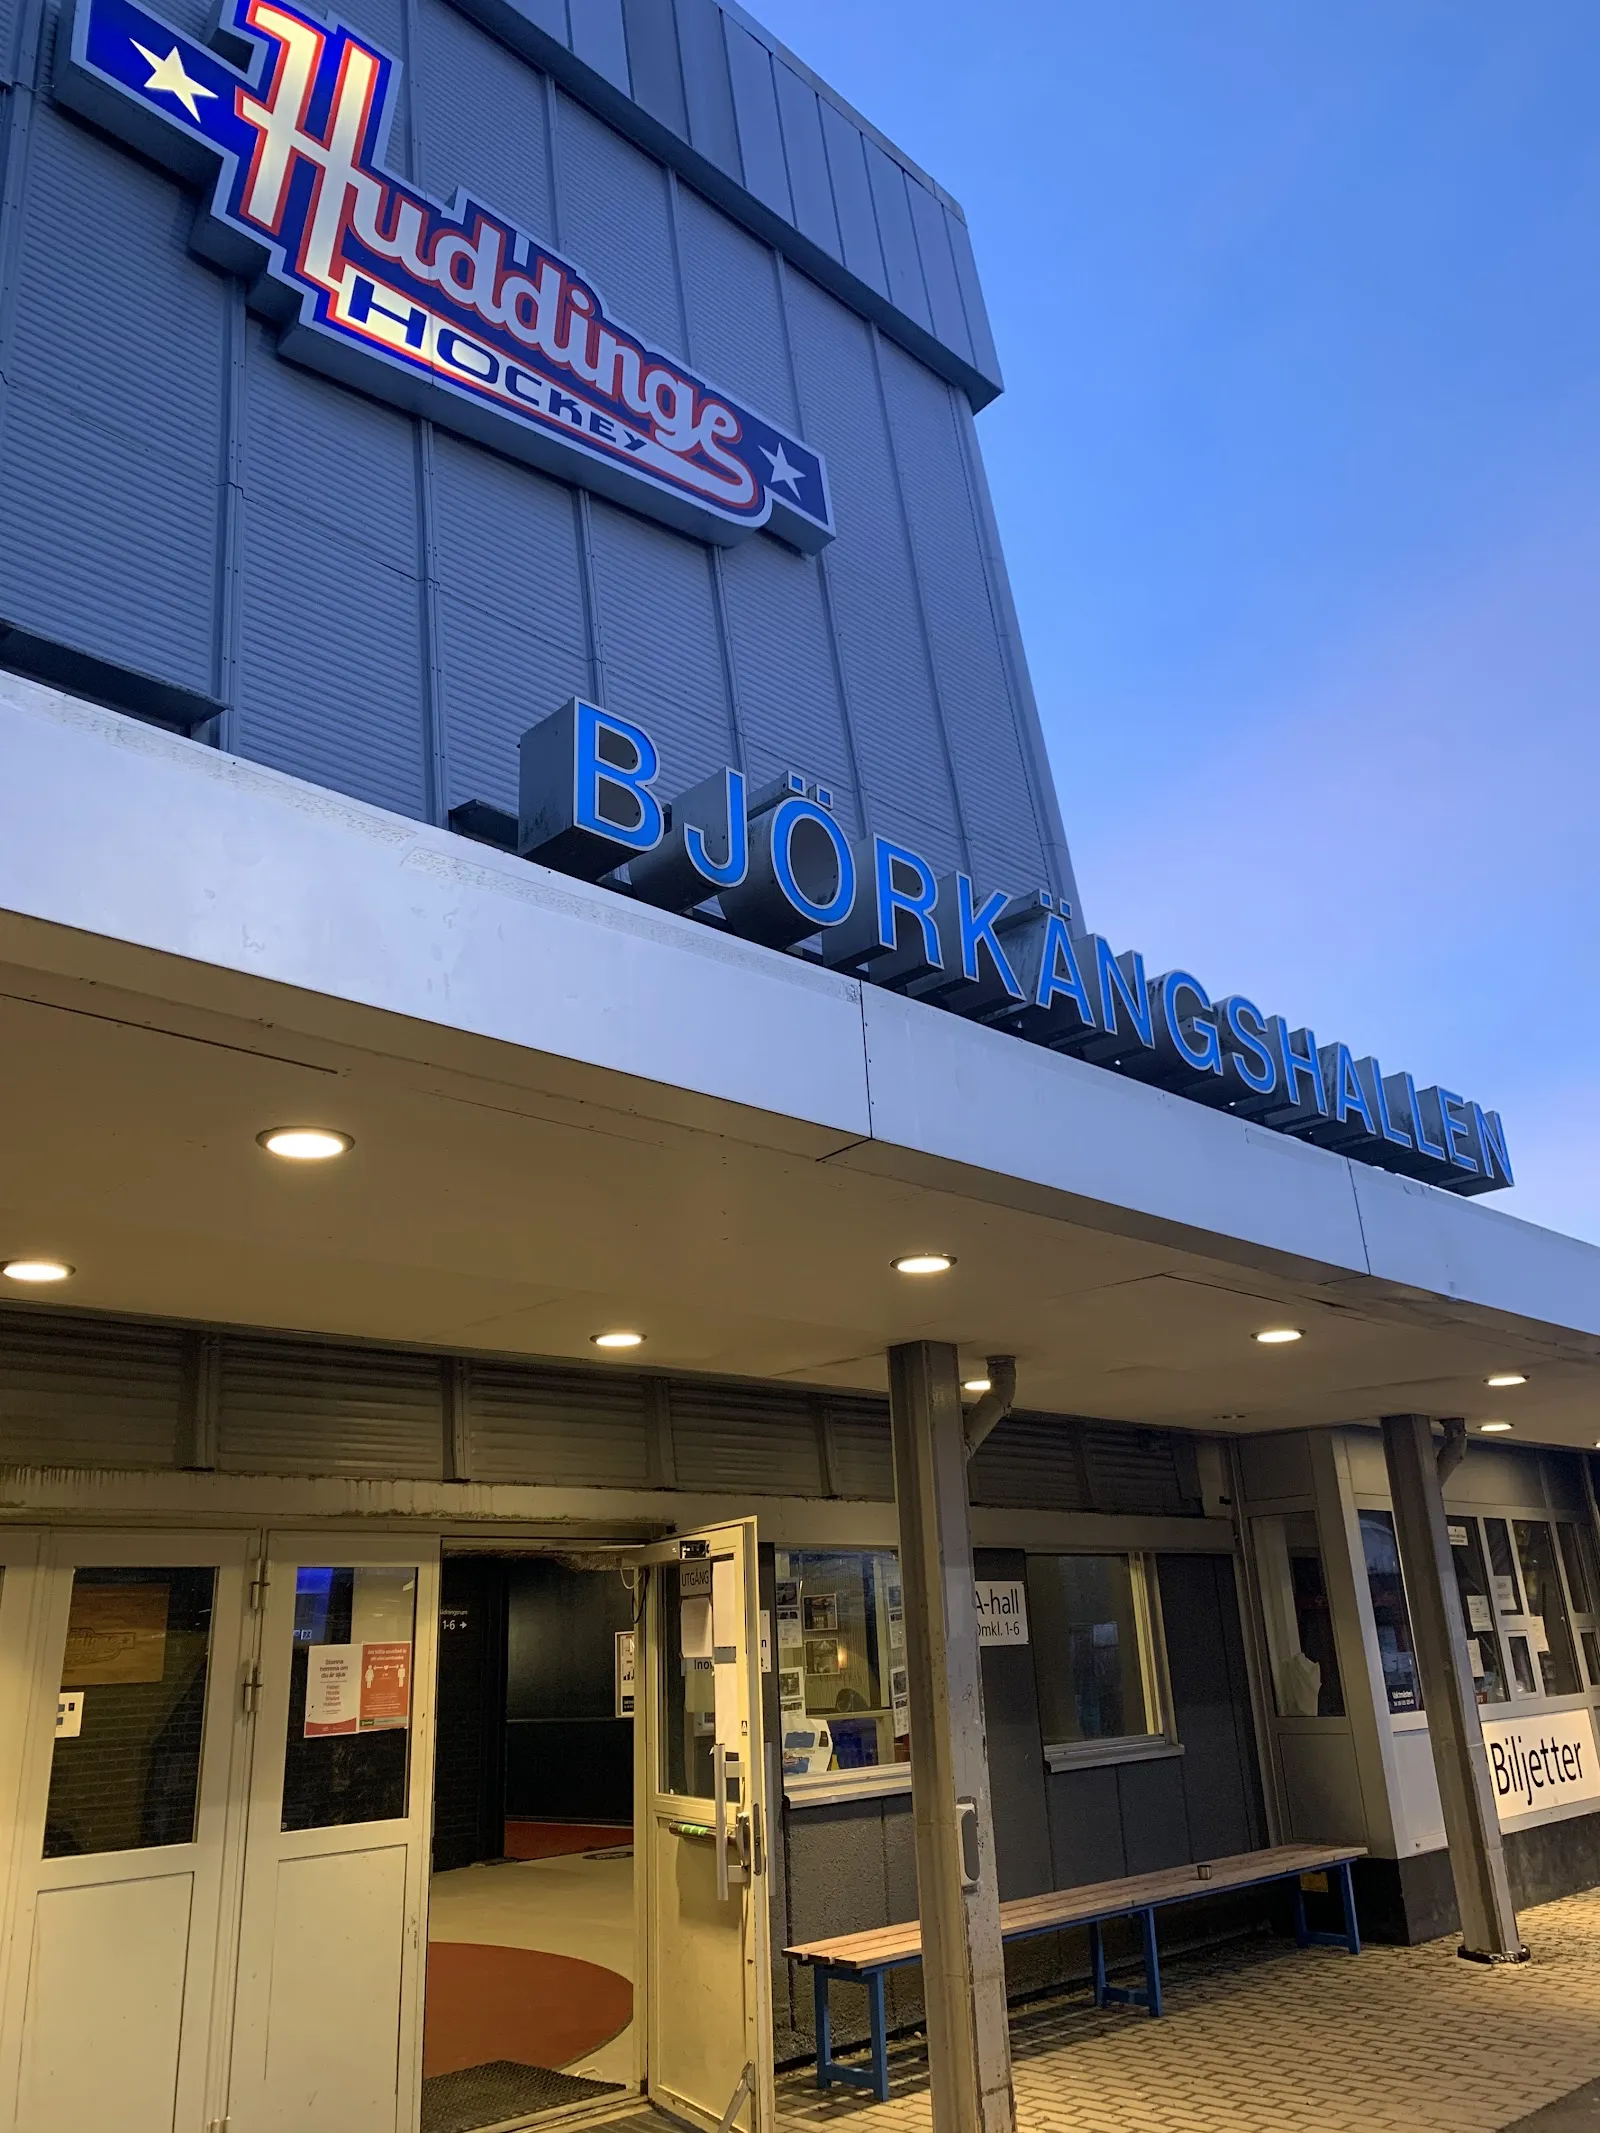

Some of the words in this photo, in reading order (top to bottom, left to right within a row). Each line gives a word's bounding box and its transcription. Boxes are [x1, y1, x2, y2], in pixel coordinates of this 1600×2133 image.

[236, 0, 757, 508] Huddinge
[347, 275, 648, 452] HOCKEY
[573, 696, 1515, 1187] BJÖRKÄNGSHALLEN
[681, 1569, 709, 1587] UTGÅNG
[442, 1619, 456, 1631] 1-6
[1005, 1621, 1020, 1636] 1-6
[1490, 1736, 1583, 1806] Biljetter
